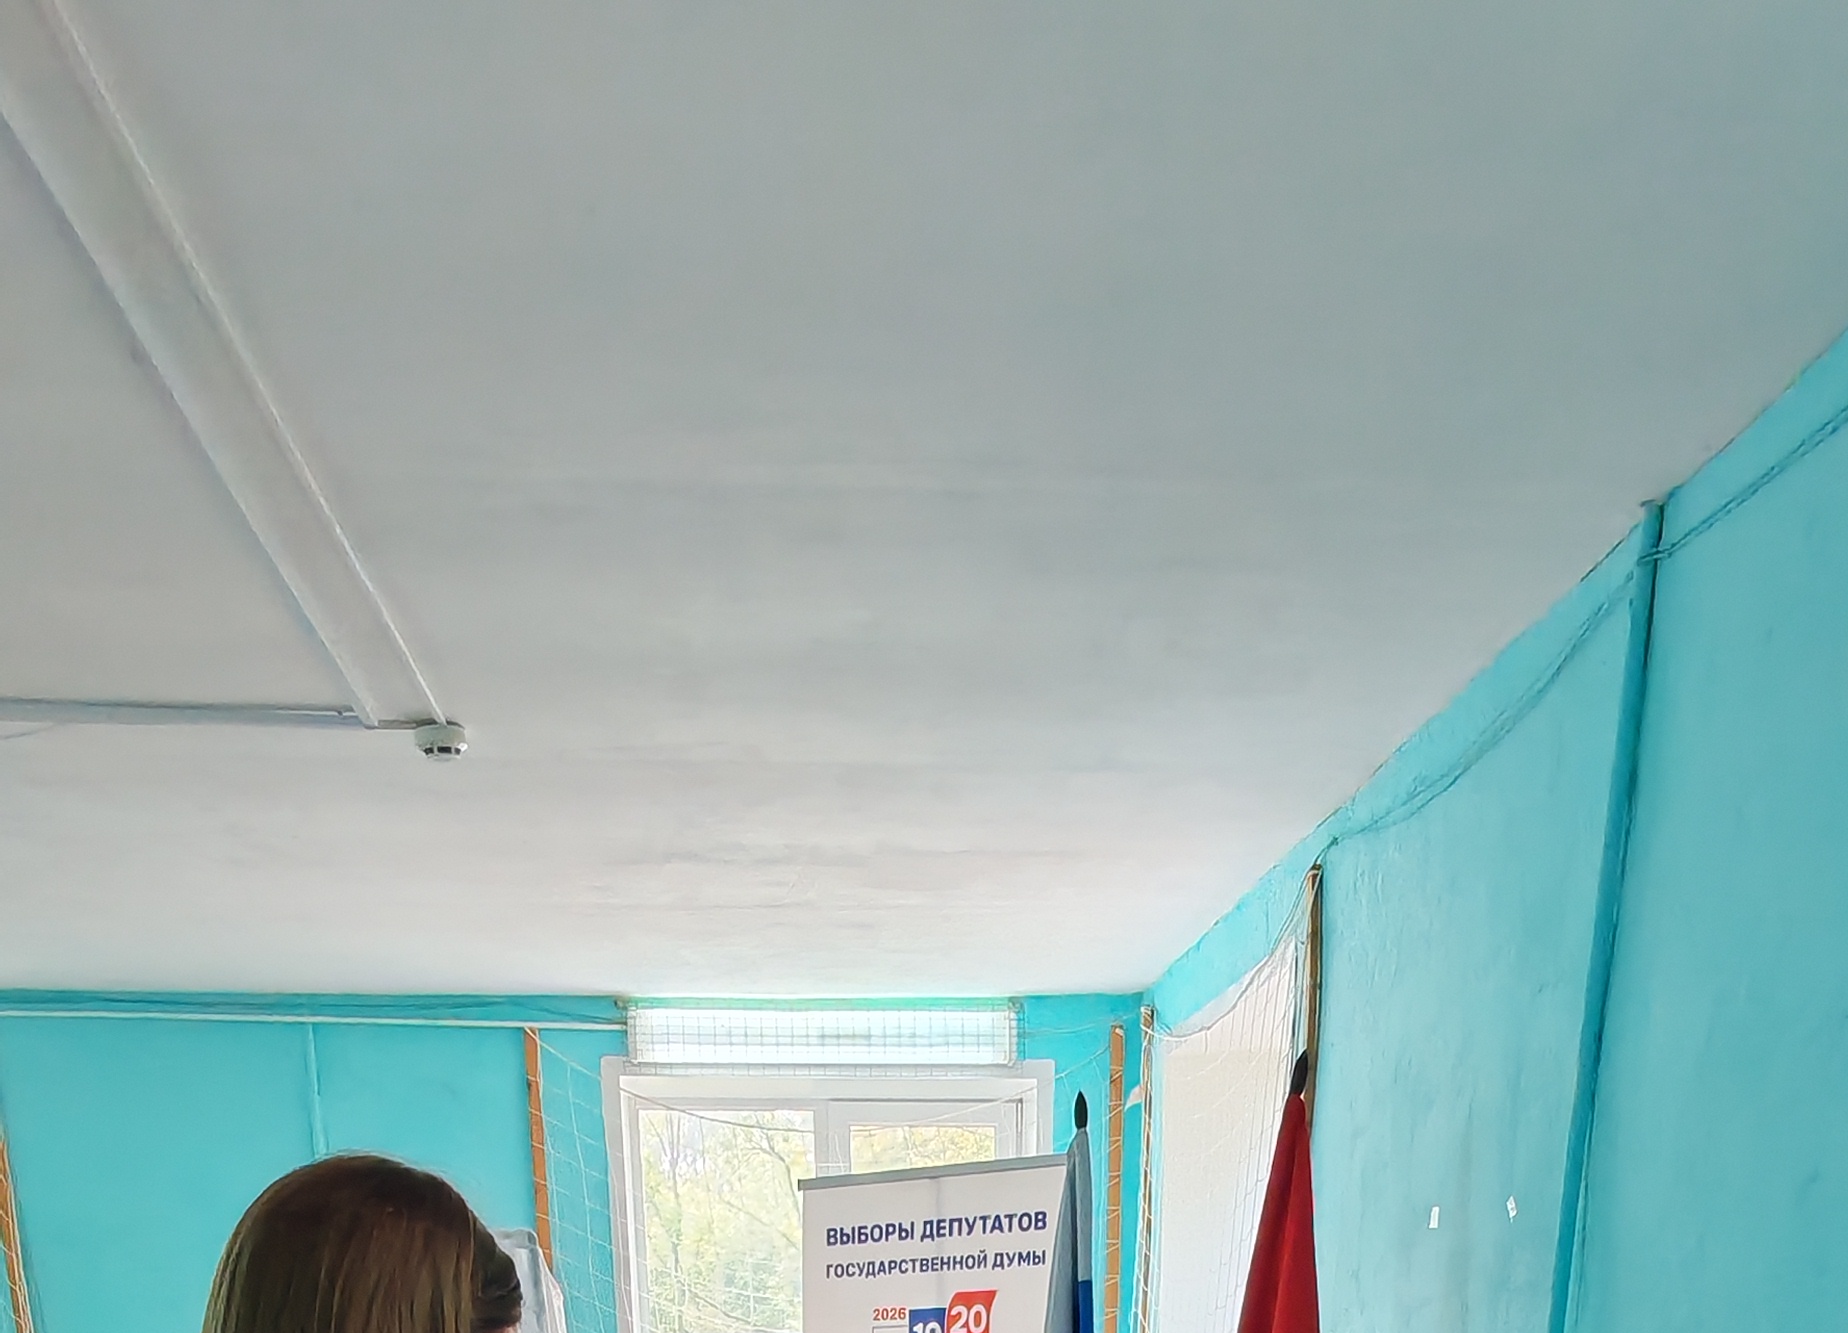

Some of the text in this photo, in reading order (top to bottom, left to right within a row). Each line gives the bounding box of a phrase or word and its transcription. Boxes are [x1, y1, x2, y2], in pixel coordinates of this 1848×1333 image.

[826, 1211, 1047, 1247] ВЫБОРЫ ДЕПУТАТОВ
[826, 1249, 1046, 1279] ГОСУДАРСТВЕННОЙ ДУМЫ
[873, 1307, 906, 1321] 2026
